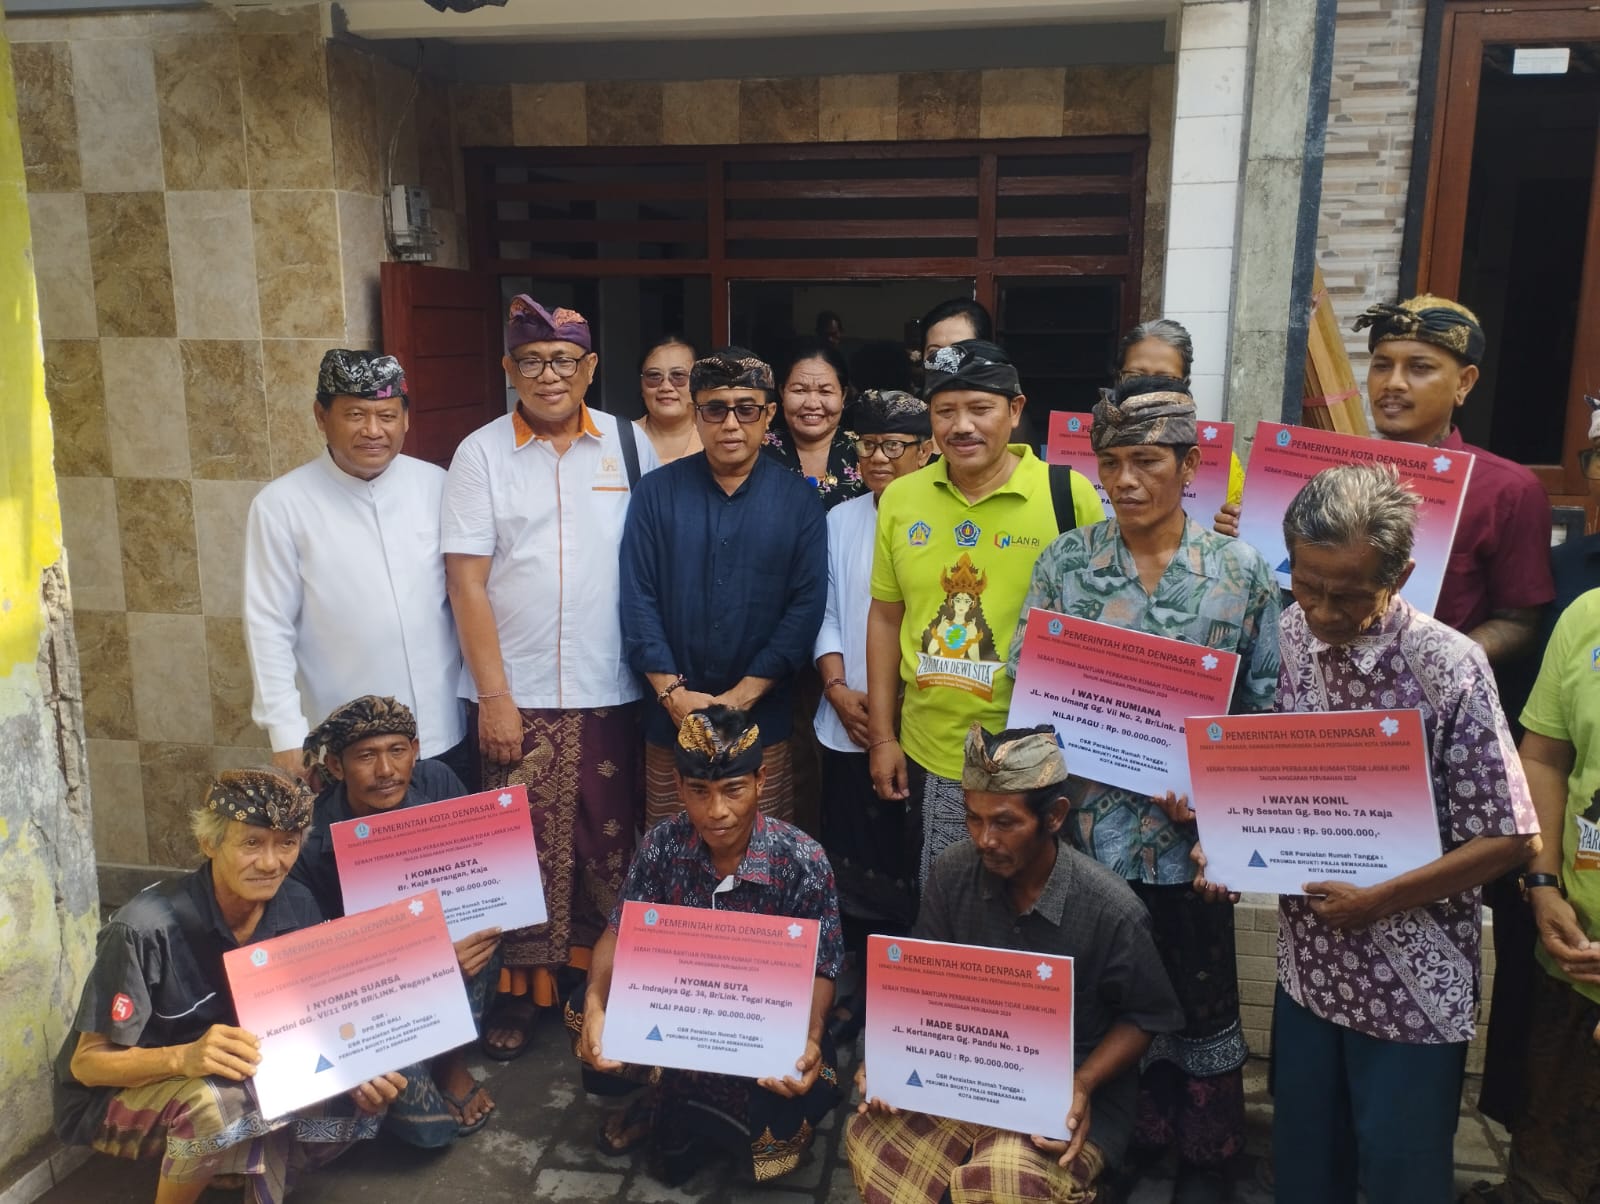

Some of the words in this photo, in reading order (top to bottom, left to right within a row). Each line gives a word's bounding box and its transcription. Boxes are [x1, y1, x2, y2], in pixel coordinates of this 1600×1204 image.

[1290, 440, 1348, 457] PEMERINTAH
[1349, 449, 1374, 461] KOTA
[1375, 453, 1427, 470] DENPASAR
[1011, 536, 1030, 545] LAN
[1063, 628, 1120, 649] PEMERINTAH
[1122, 642, 1146, 655] KOTA
[1147, 648, 1196, 667] DENPASAR
[950, 660, 972, 678] DEWI
[973, 663, 991, 684] SITA
[1029, 688, 1042, 697] JL.
[1043, 692, 1059, 701] Ken
[1060, 696, 1088, 710] Umang
[1089, 704, 1104, 714] Gg.
[1118, 711, 1133, 720] No.
[1178, 726, 1187, 734] B
[1071, 688, 1075, 696] I
[1076, 689, 1112, 705] WAYAN
[1115, 698, 1162, 718] RUMIANA
[1051, 710, 1074, 722] NILAI
[1075, 716, 1099, 728] PAGU
[1105, 724, 1120, 735] Rp.
[1224, 729, 1287, 741] PEMERINTAH
[1289, 729, 1316, 739] KOTA
[1318, 727, 1375, 738] DENPASAR
[1262, 795, 1266, 804] I
[1268, 795, 1309, 804] WAYAN
[1312, 795, 1348, 804] KONIL
[372, 816, 427, 835] PEMERINTAH
[429, 812, 451, 823] KOTA
[453, 802, 495, 818] DENPASAR
[1242, 807, 1254, 816] Ry
[1294, 808, 1311, 817] Gg.
[1313, 808, 1332, 816] Beo
[1368, 809, 1393, 819] Kaja
[1241, 825, 1266, 833] NILAI
[1268, 825, 1295, 834] PAGU
[1302, 827, 1318, 837] Rp.
[1581, 823, 1600, 850] PAR
[404, 872, 408, 880] I
[410, 863, 451, 879] KOMANG
[453, 857, 478, 869] ASTA
[410, 879, 429, 889] Kaja
[470, 865, 488, 875] Kaja
[441, 887, 454, 897] Rp.
[659, 917, 713, 931] PEMERINTAH
[714, 923, 736, 933] KOTA
[738, 925, 783, 938] DENPASAR
[903, 954, 957, 969] PEMERINTAH
[960, 960, 981, 972] KOTA
[984, 963, 1032, 978] DENPASAR
[312, 987, 358, 1010] NYOMAN
[360, 973, 400, 993] SUARSA
[641, 983, 678, 995] Indrajaya
[679, 988, 693, 997] Gg.
[741, 994, 762, 1005] Tegal
[764, 997, 793, 1008] Kangin
[673, 976, 677, 984] I
[679, 976, 721, 989] NYOMAN
[723, 981, 748, 992] SUTA
[265, 1020, 296, 1038] Kartini
[431, 965, 455, 979] Kelod
[649, 1001, 671, 1011] NILAI
[673, 1004, 695, 1013] PAGU
[702, 1007, 715, 1017] Rp.
[920, 1017, 923, 1026] I
[925, 1018, 952, 1030] MADE
[955, 1023, 1009, 1039] SUKADANA
[892, 1025, 903, 1033] JL.
[906, 1027, 954, 1042] Kertanegara
[956, 1035, 969, 1045] Gg.
[972, 1037, 997, 1048] Pandu
[1000, 1042, 1013, 1051] No.
[1016, 1044, 1021, 1052] 1
[1023, 1045, 1039, 1056] Dps
[905, 1045, 926, 1055] NILAI
[929, 1048, 951, 1059] PAGU
[958, 1053, 972, 1064] Rp.
